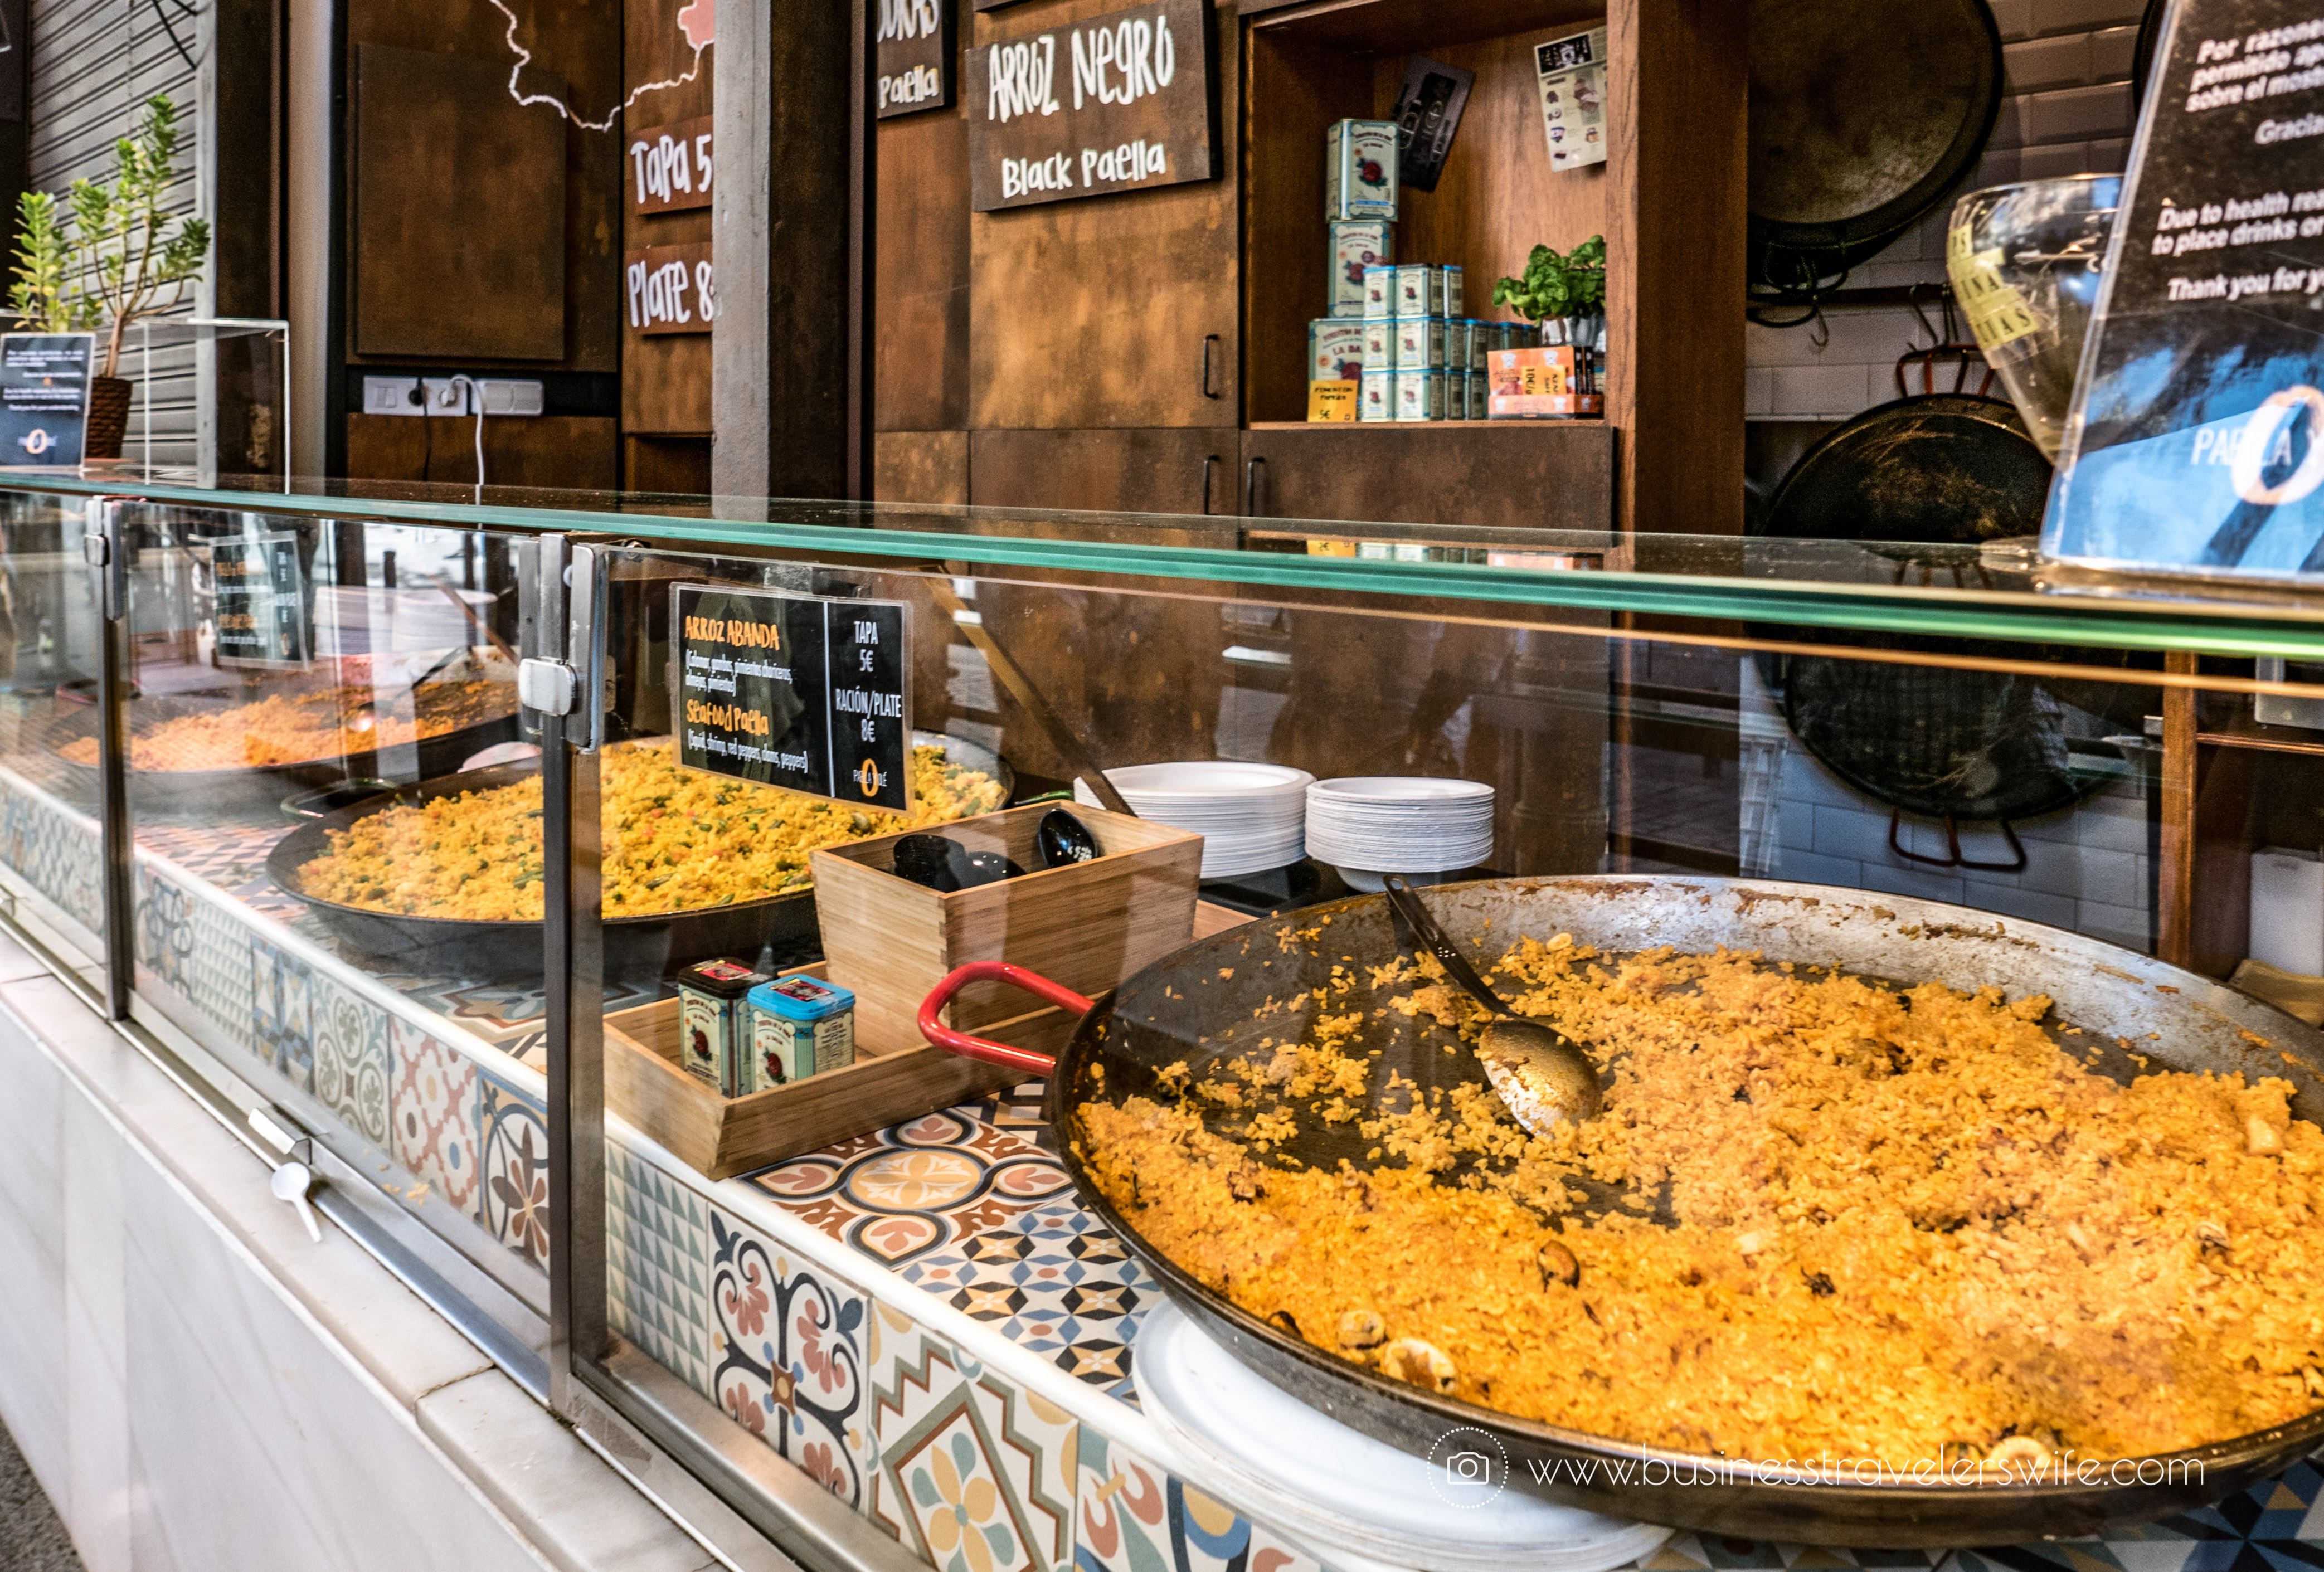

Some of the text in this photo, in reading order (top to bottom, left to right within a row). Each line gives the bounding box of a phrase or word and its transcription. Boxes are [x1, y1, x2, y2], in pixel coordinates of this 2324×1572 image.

[2196, 38, 2239, 64] Por
[878, 64, 940, 109] Paella
[988, 35, 1059, 123] ARROZ
[2185, 85, 2244, 113] sobre
[2244, 75, 2268, 101] el
[696, 133, 713, 193] 5
[1003, 139, 1166, 199] Black Paella
[2157, 207, 2198, 231] Due
[2199, 202, 2224, 225] to
[2223, 191, 2289, 221] health
[2151, 233, 2174, 256] to
[2172, 228, 2229, 257] place
[2230, 216, 2297, 246] drinks
[694, 260, 714, 322] 8
[2167, 273, 2229, 301] Thank
[2226, 275, 2270, 301] you
[2272, 266, 2307, 291] for
[685, 615, 780, 651] ARROZ ABANDA
[854, 620, 879, 645] TAPA
[859, 649, 874, 672] 5€
[835, 685, 902, 719] RACIÓN/PLATE
[860, 718, 875, 743] 8€
